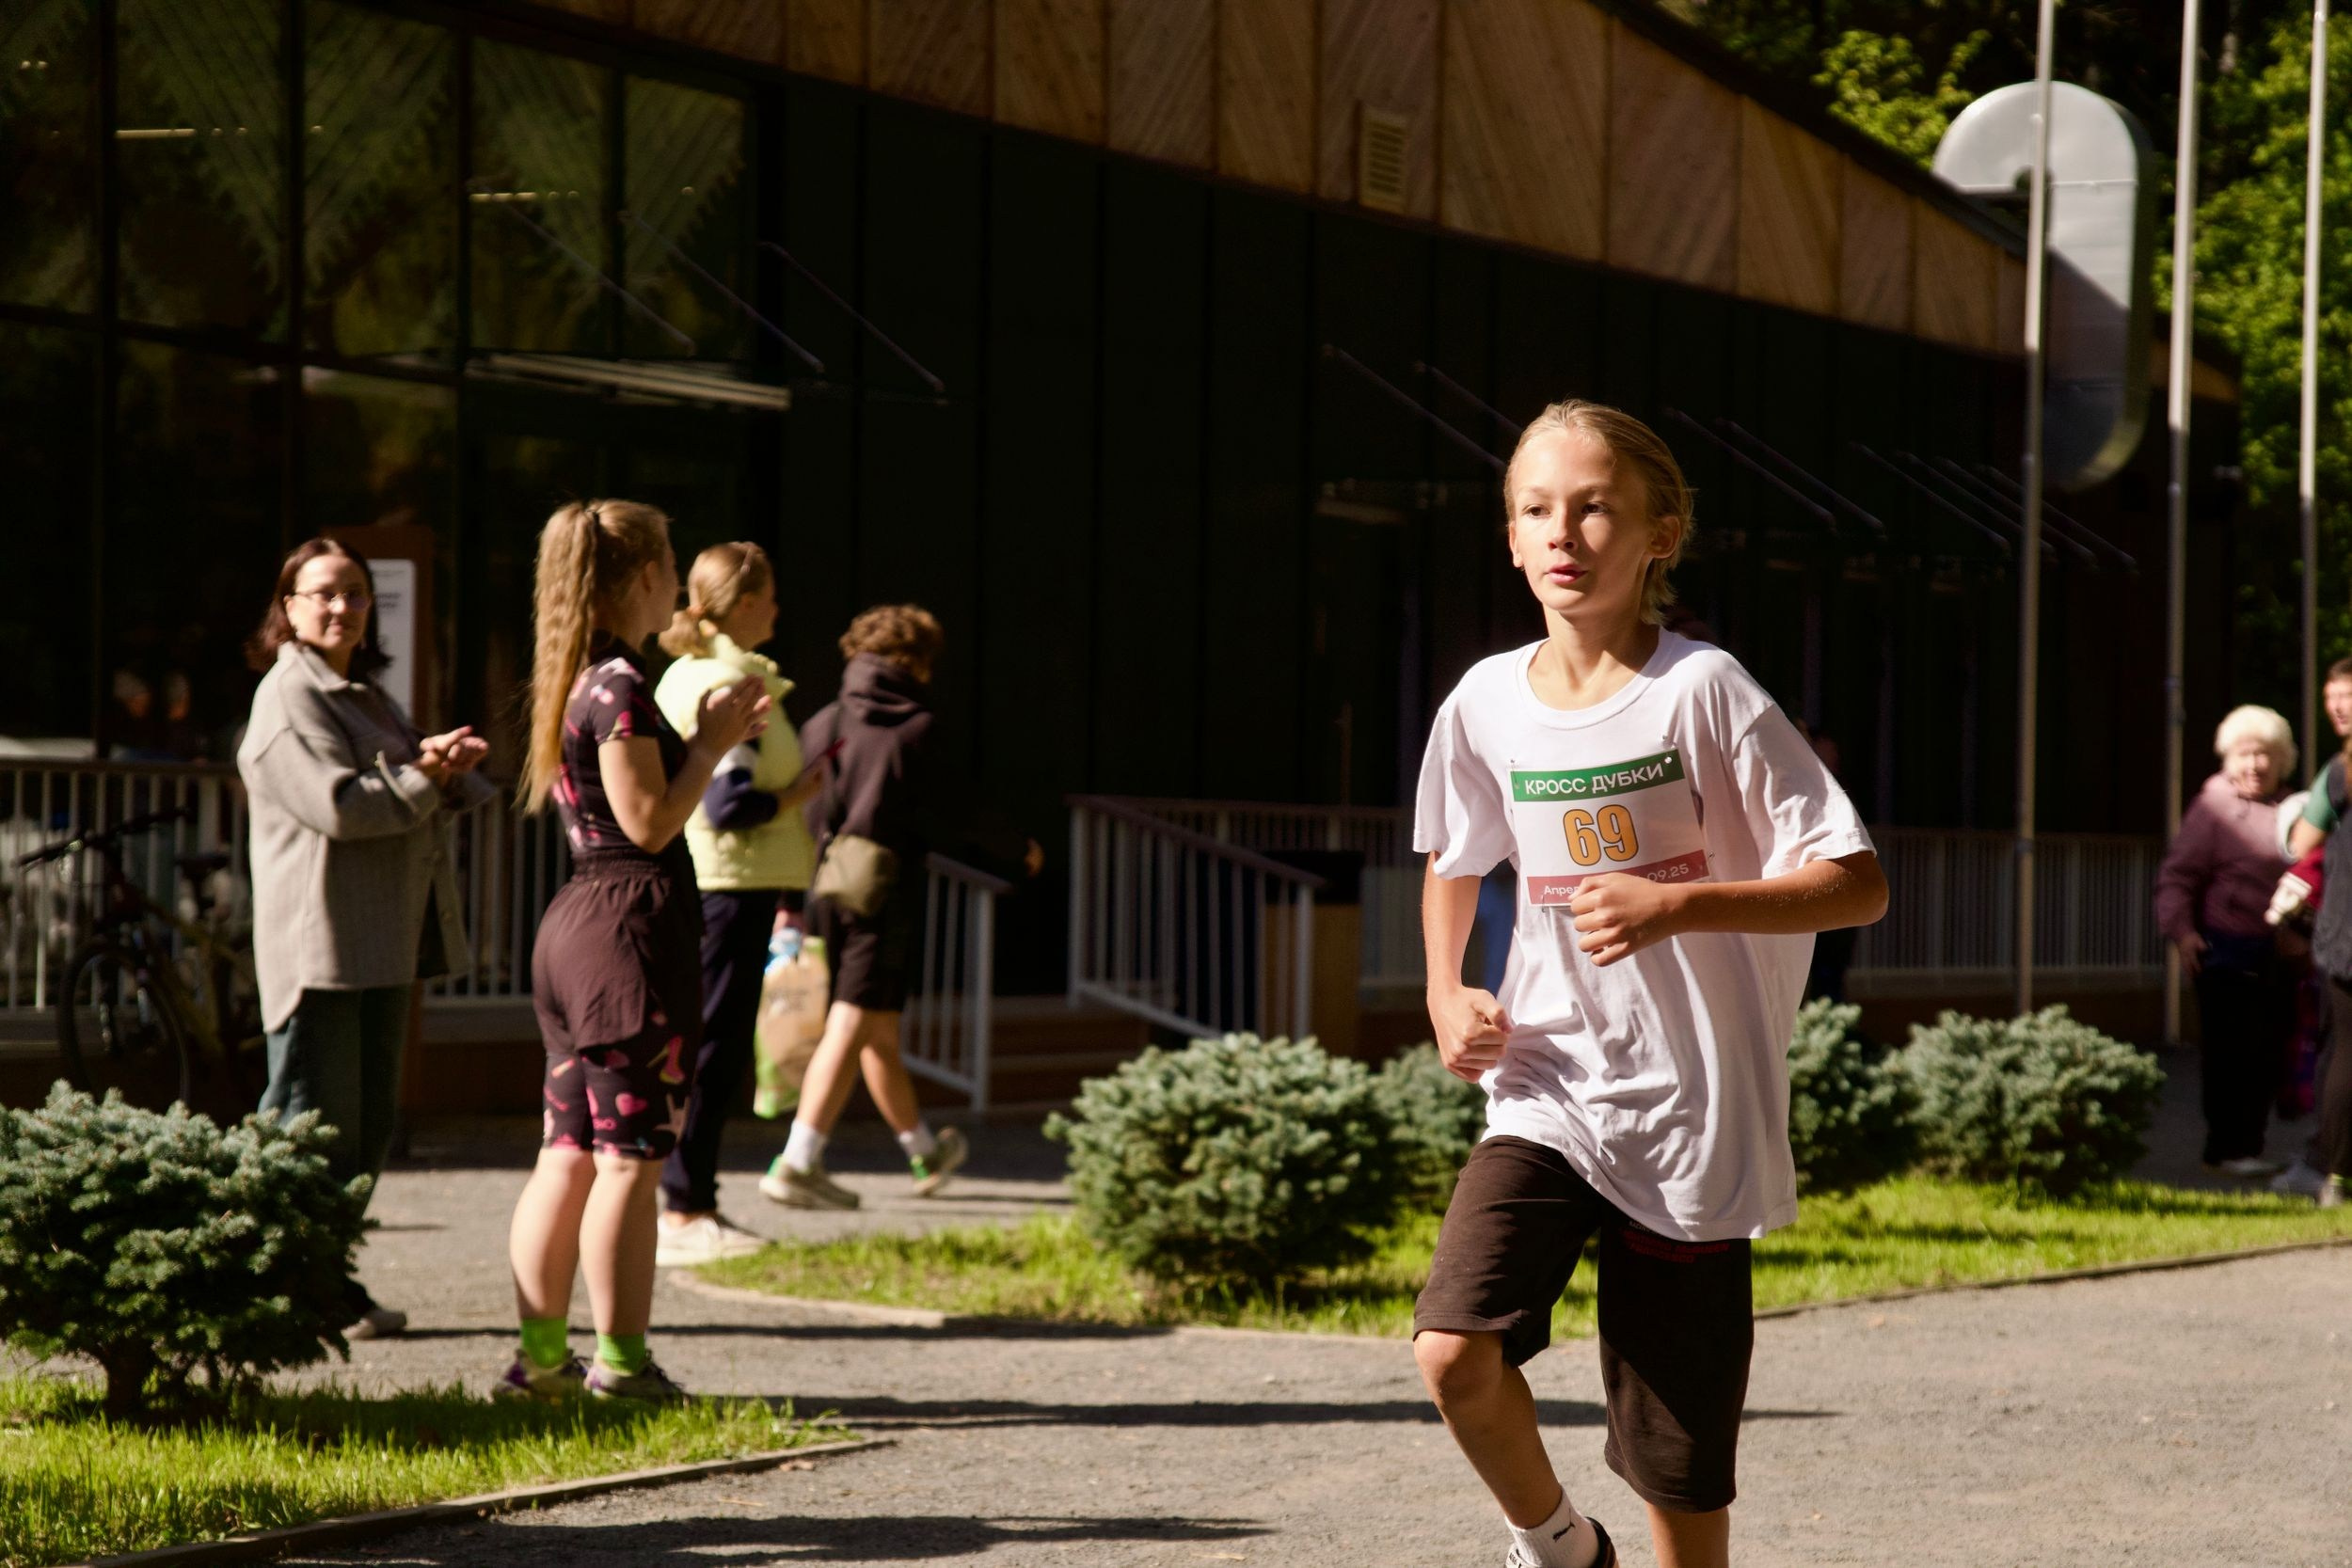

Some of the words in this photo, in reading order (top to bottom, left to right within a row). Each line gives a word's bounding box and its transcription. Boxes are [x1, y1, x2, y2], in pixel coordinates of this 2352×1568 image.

[1524, 778, 1587, 796] КРОСС
[1591, 763, 1664, 794] ДУБКИ
[1563, 804, 1640, 867] 69
